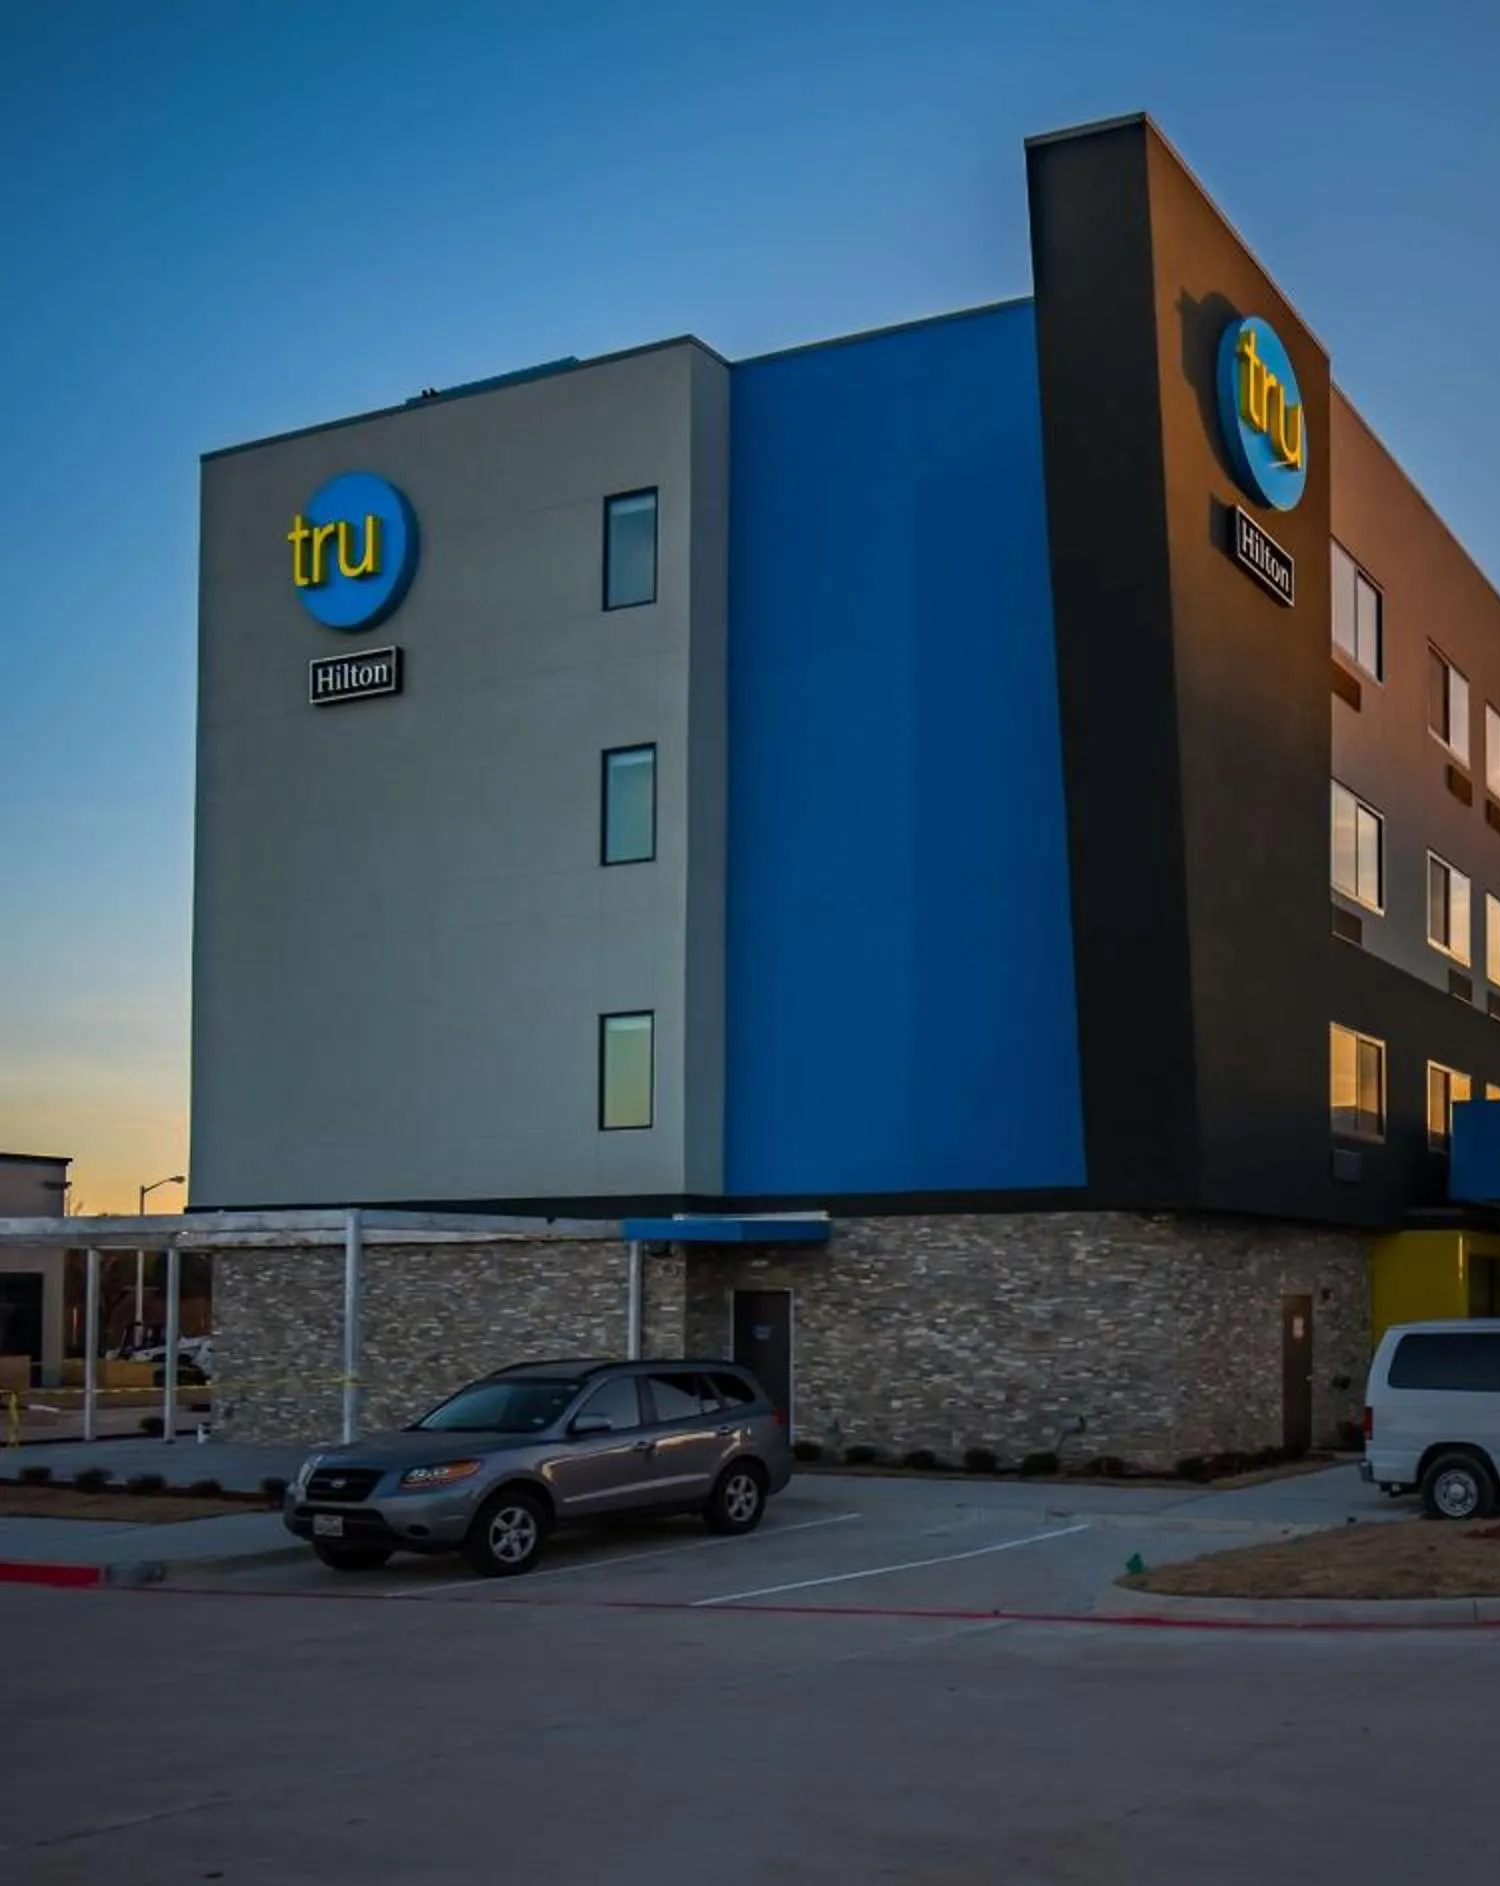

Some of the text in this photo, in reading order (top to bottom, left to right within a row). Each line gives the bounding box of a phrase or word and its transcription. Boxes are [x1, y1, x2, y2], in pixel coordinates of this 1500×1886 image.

[1238, 329, 1302, 469] tru
[287, 513, 379, 587] tru
[1241, 519, 1290, 593] Hilton
[316, 660, 389, 694] Hilton
